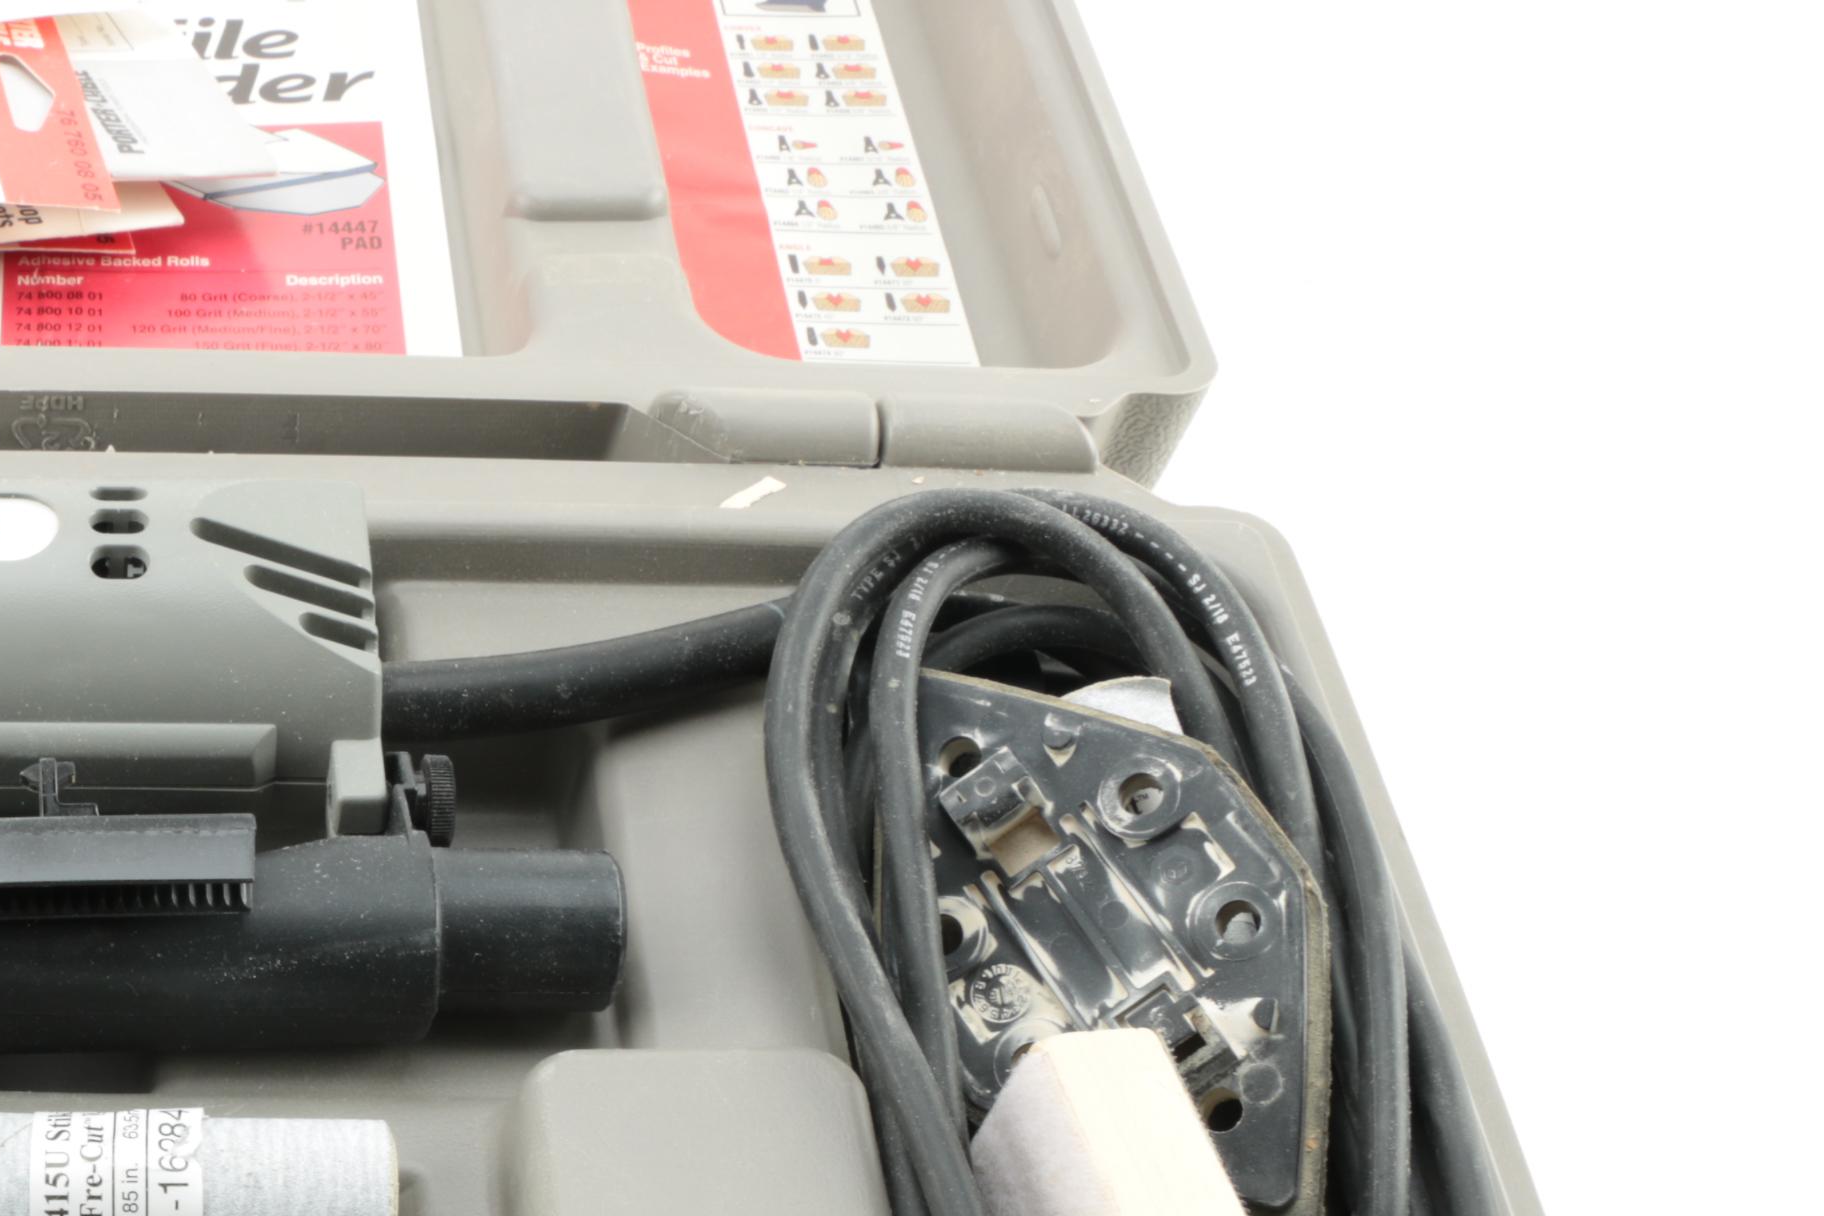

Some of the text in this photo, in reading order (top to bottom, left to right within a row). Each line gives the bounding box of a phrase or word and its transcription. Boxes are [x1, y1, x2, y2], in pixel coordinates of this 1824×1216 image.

[636, 42, 690, 58] Profiles
[653, 54, 678, 65] Cut
[640, 64, 710, 78] Examples
[302, 220, 380, 235] #14447
[342, 236, 383, 250] PAD
[18, 256, 210, 267] Adhesive Backed Rolls
[17, 275, 84, 286] Number
[285, 274, 384, 287] Description
[88, 292, 103, 300] 01
[202, 293, 227, 302] Grit
[17, 307, 102, 317] 74 800 10 01
[167, 309, 191, 318] 100
[196, 309, 222, 318] Grit
[16, 323, 102, 333] 74 800 12 01
[132, 325, 156, 334] 120
[161, 325, 187, 334] Grit
[850, 566, 885, 600] TYPE
[1187, 573, 1207, 594] SJ
[122, 1190, 139, 1214] 85
